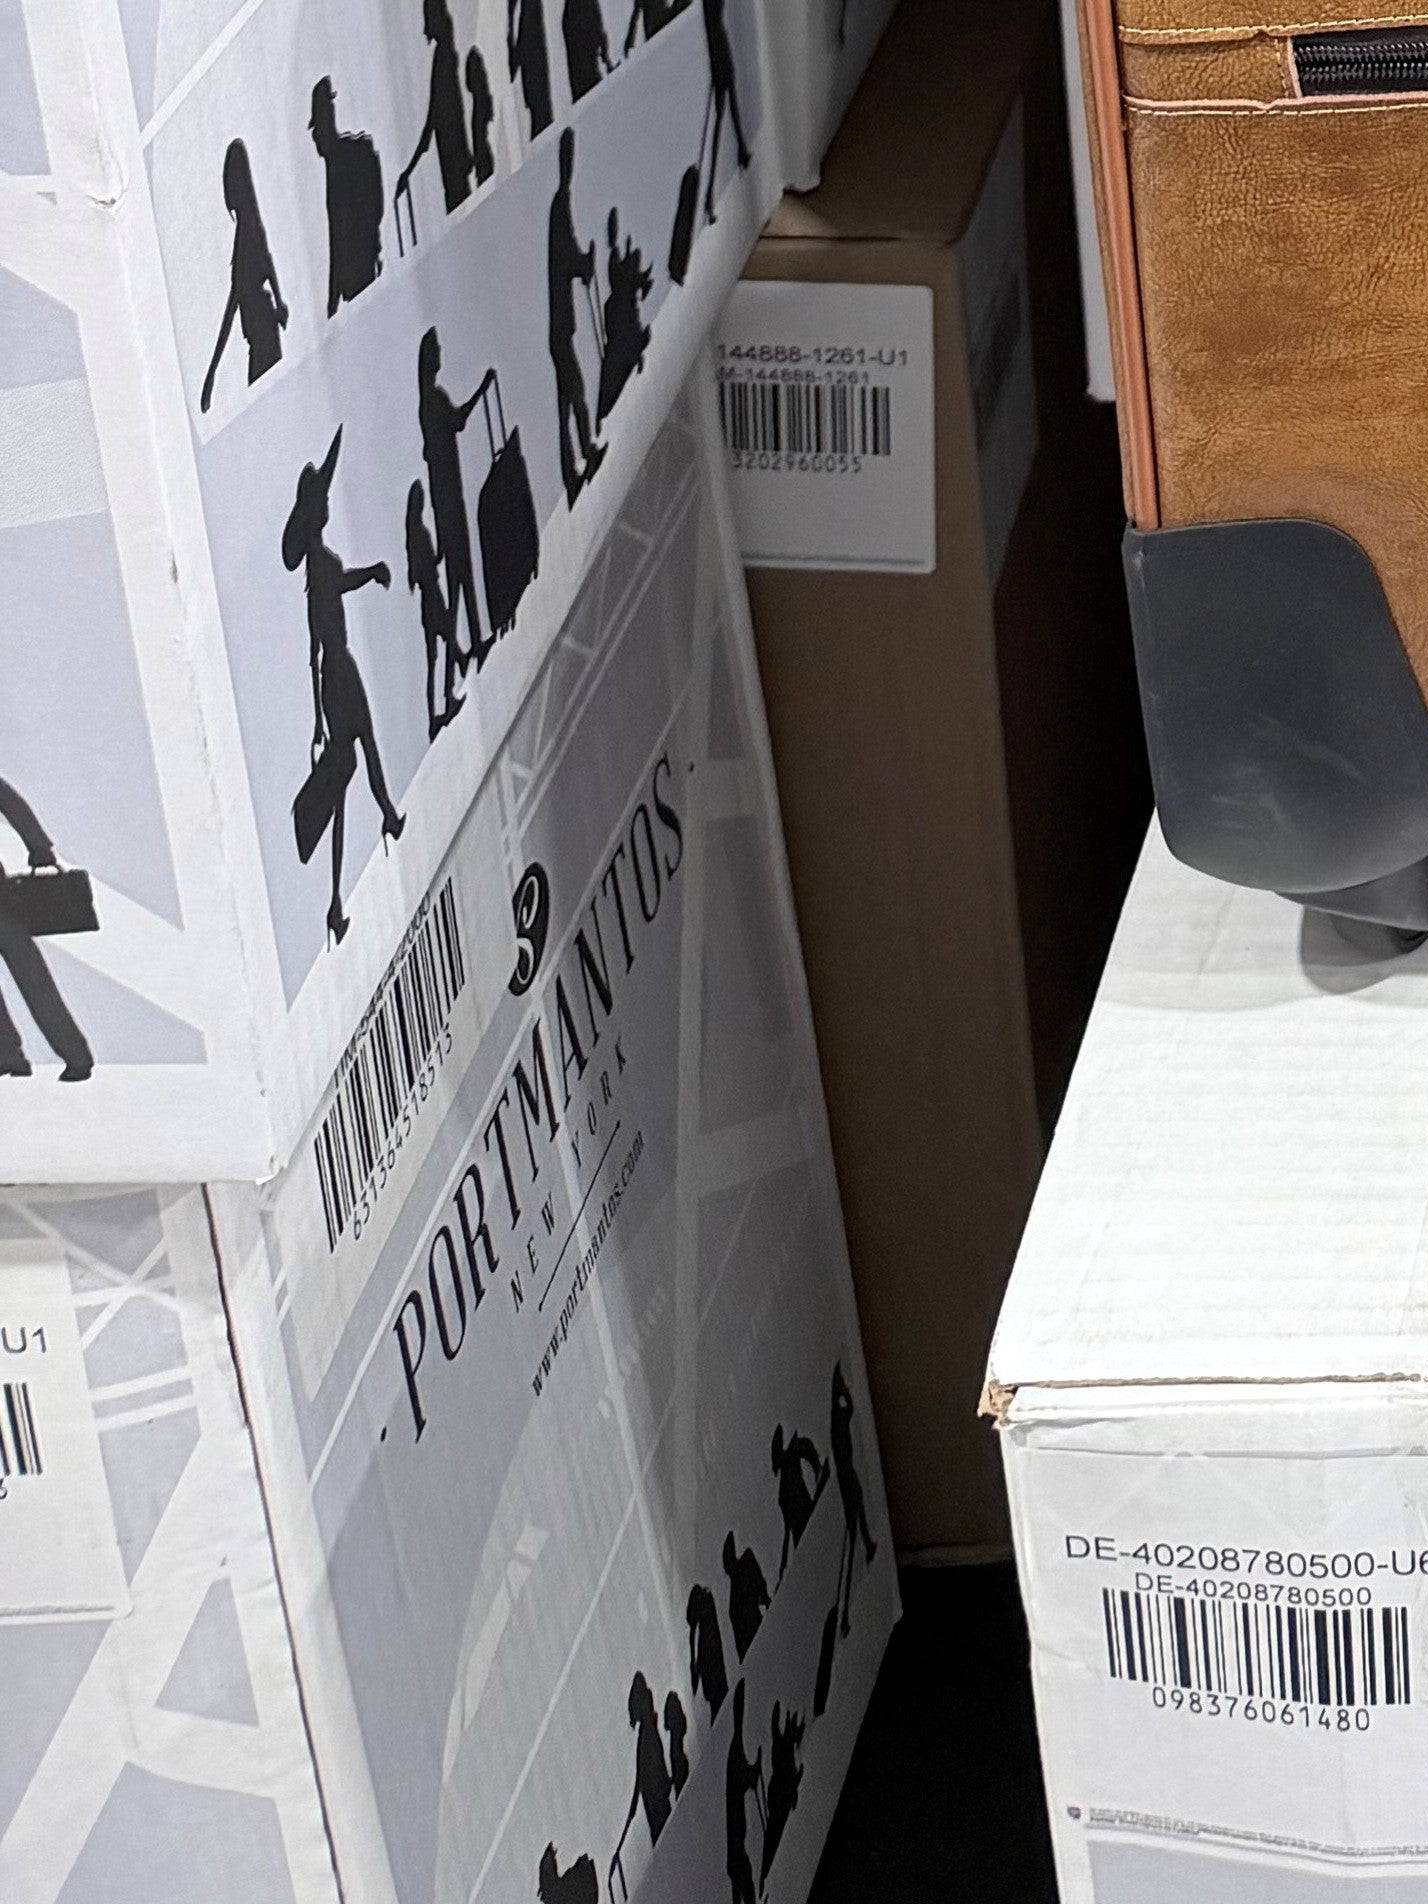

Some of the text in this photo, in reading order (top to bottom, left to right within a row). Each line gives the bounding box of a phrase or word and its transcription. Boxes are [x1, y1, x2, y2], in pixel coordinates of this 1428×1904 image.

[392, 751, 685, 1445] PORTMANTOS
[508, 1035, 629, 1314] NEW YORK
[531, 1129, 645, 1398] www.portmantos.com
[1134, 1571, 1372, 1608] DE-40208780500
[1152, 1686, 1371, 1732] 098376061480
